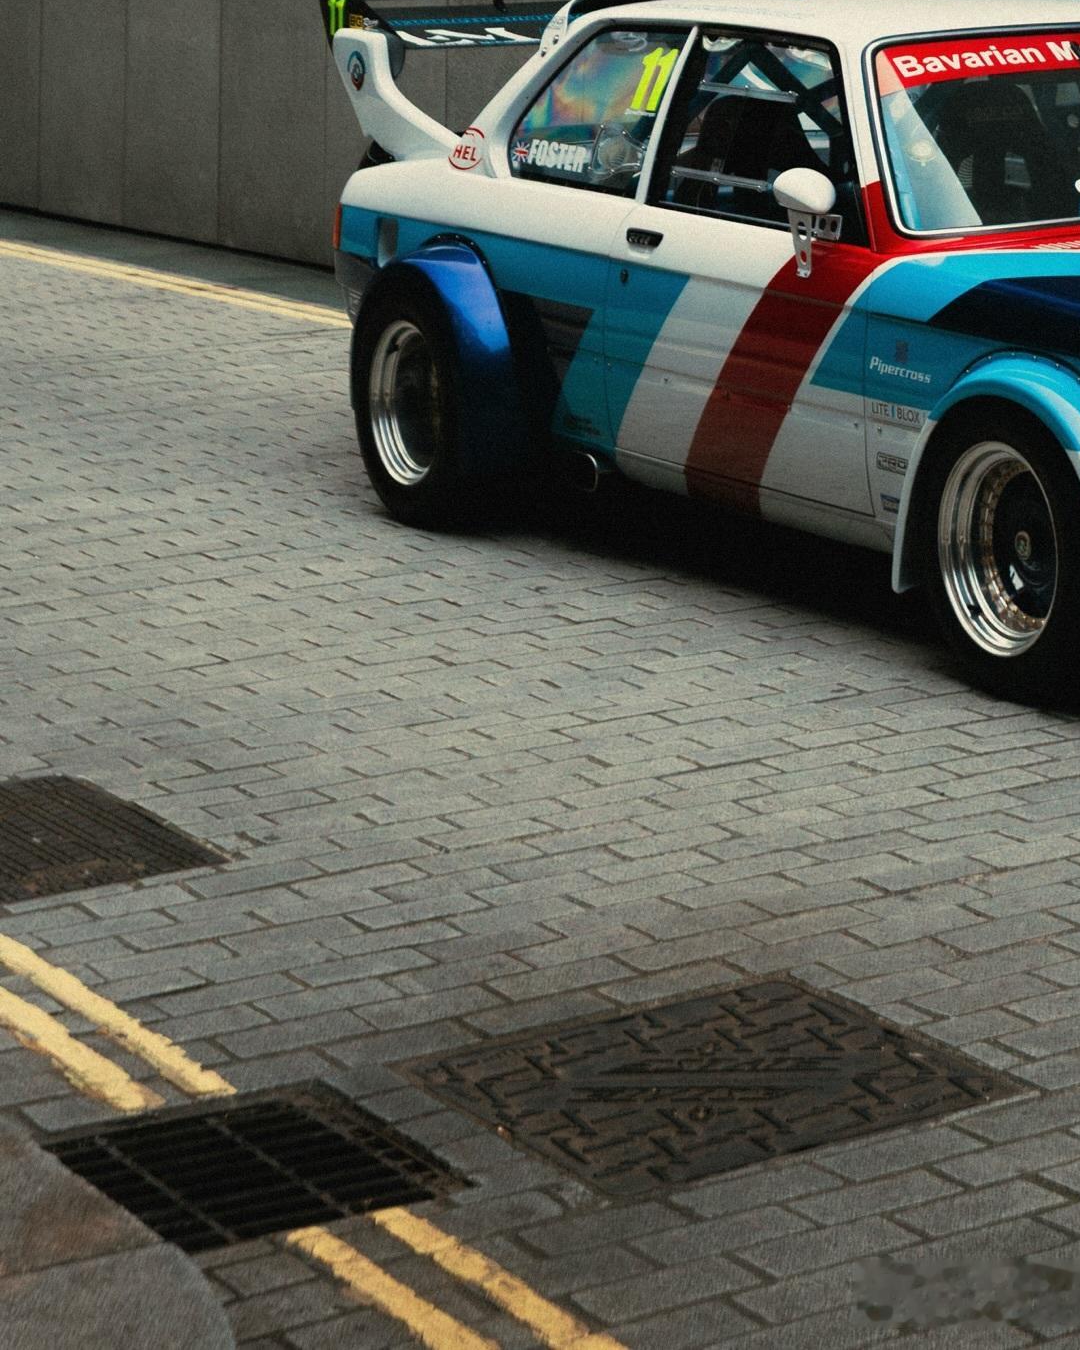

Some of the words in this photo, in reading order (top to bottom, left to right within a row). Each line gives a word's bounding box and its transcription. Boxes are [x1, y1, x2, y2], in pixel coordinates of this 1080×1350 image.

[892, 45, 1046, 78] Bavarian
[631, 47, 679, 112] 11
[455, 144, 477, 162] HEL
[528, 137, 588, 174] FOSTER
[869, 356, 931, 383] Pipercross
[872, 402, 889, 417] LITE
[896, 406, 920, 424] BLOX
